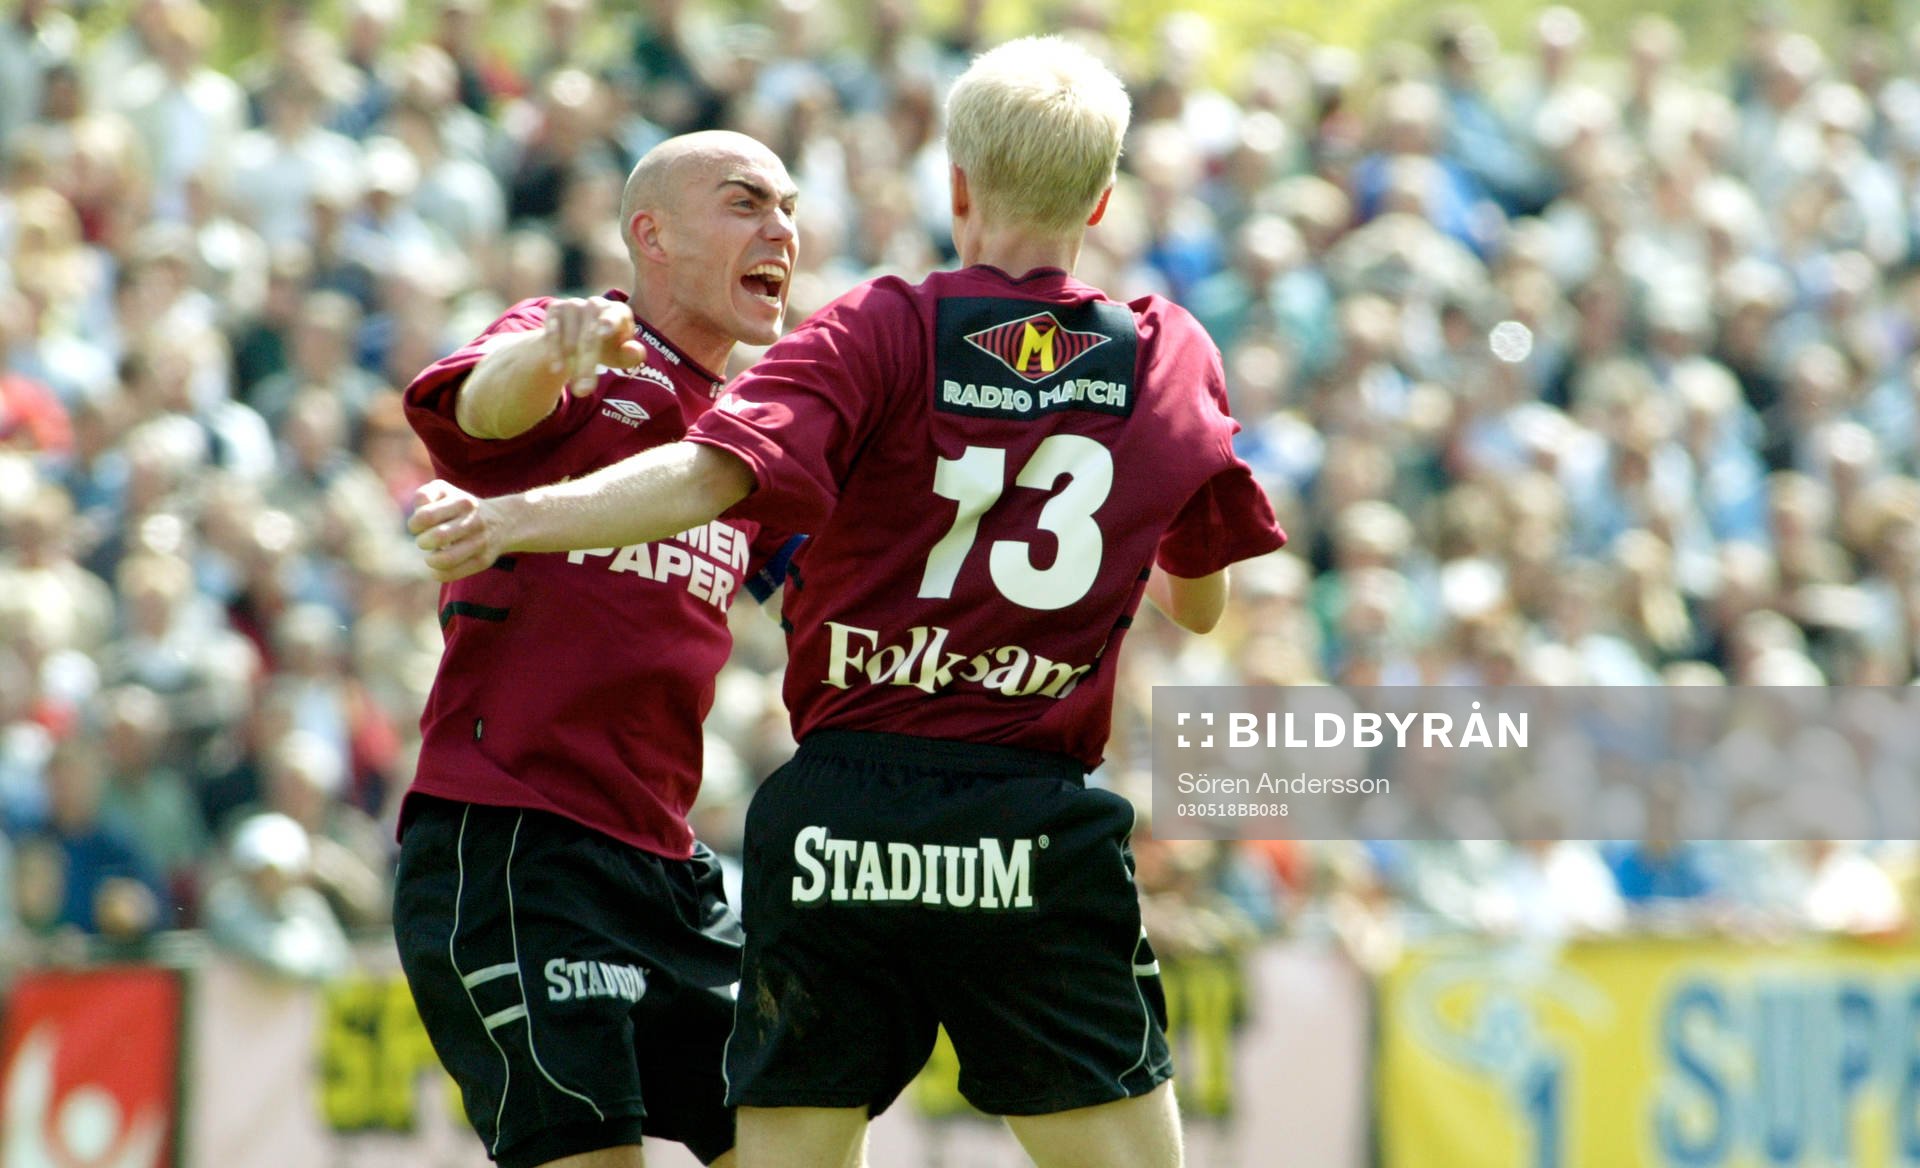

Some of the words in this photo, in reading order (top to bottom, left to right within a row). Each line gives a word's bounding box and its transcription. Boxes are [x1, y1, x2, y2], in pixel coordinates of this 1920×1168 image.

[642, 331, 681, 366] HOLMEN
[1015, 321, 1057, 372] M
[943, 380, 1033, 413] RADIO
[1039, 379, 1127, 408] MATCH
[668, 519, 750, 576] MEN
[917, 434, 1114, 610] 13
[821, 621, 1092, 700] Folksam
[1658, 978, 1920, 1166] SUP
